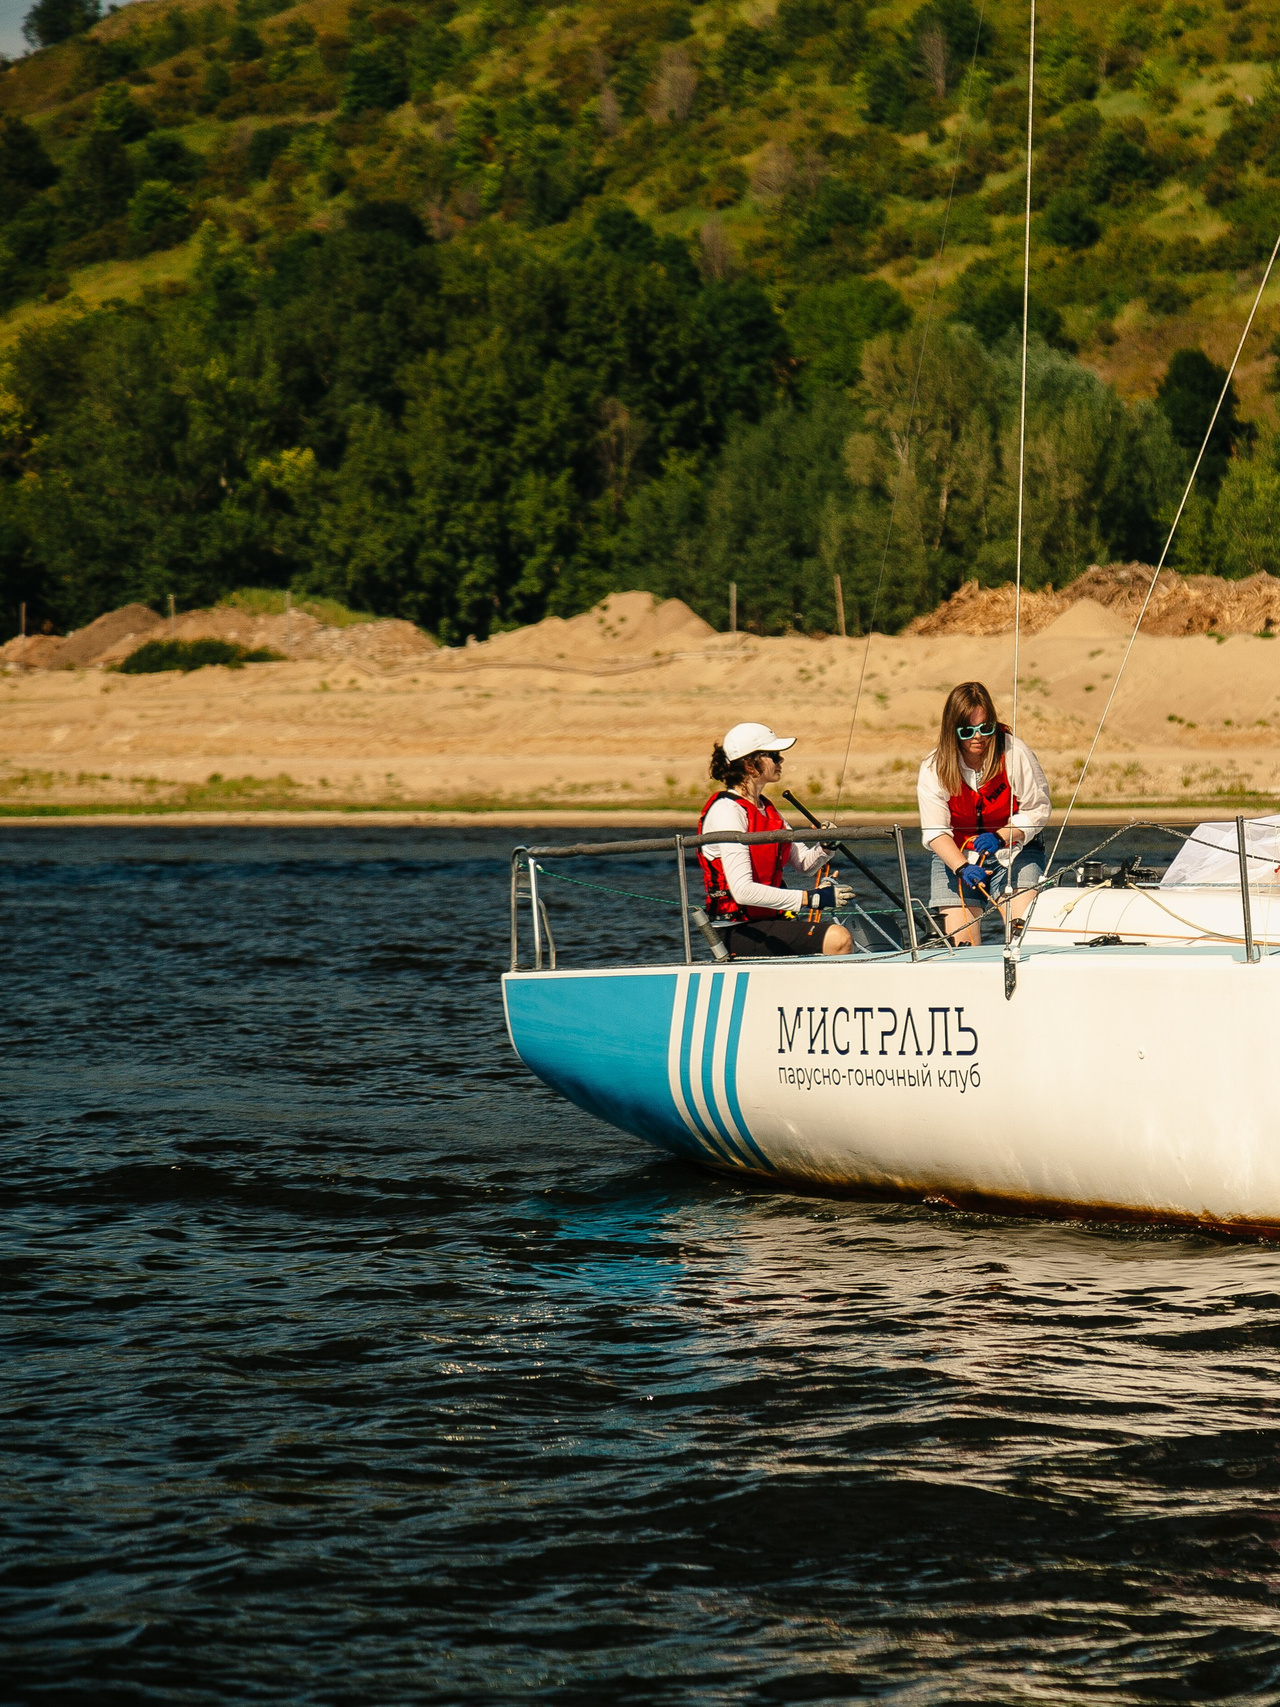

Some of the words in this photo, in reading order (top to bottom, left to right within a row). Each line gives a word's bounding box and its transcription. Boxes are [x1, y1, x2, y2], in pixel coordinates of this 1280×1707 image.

[777, 1006, 979, 1056] МИСТРАЛЬ
[778, 1063, 933, 1091] парусно-гоночный
[937, 1062, 982, 1094] клуб
